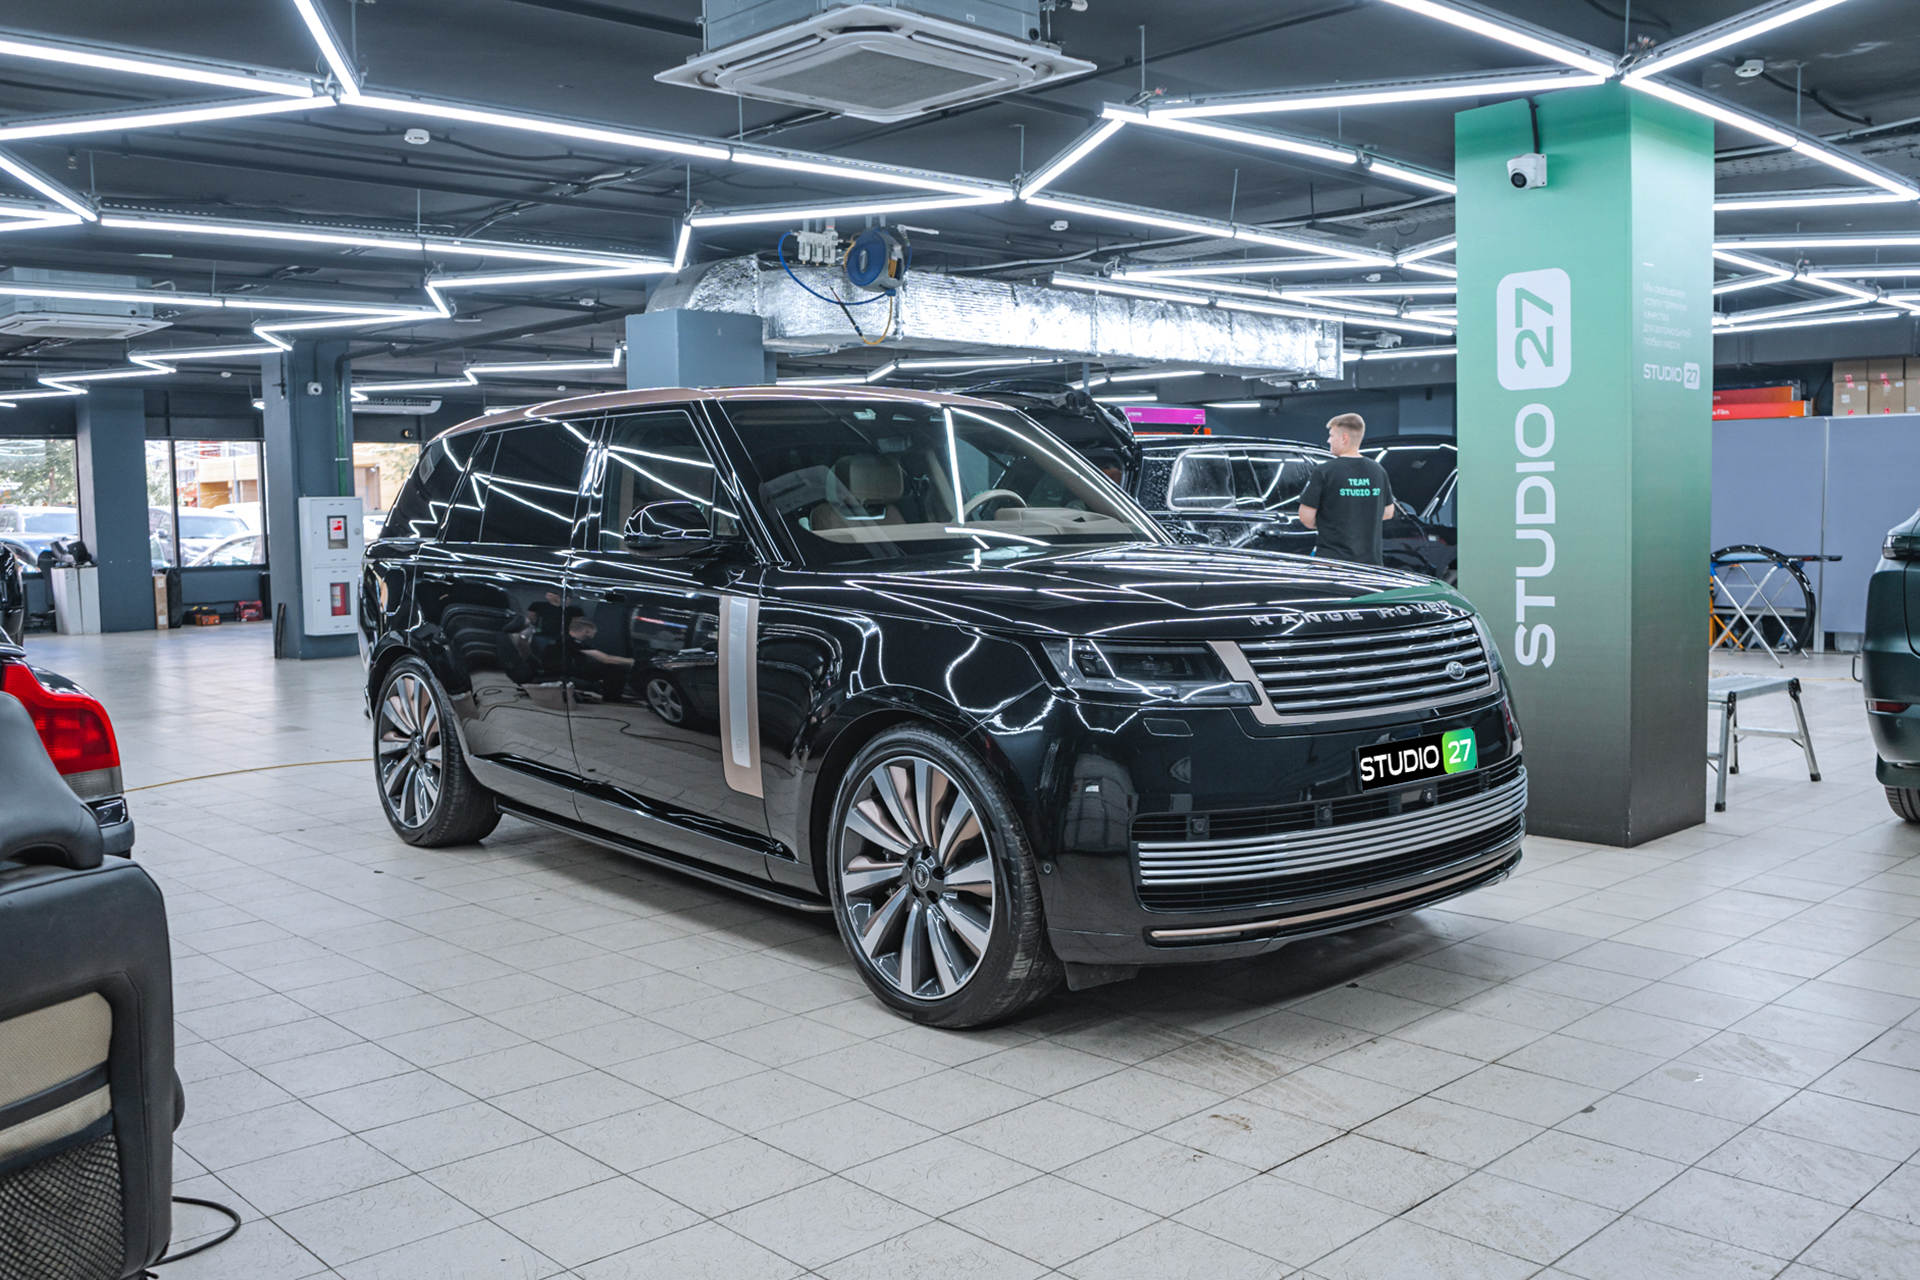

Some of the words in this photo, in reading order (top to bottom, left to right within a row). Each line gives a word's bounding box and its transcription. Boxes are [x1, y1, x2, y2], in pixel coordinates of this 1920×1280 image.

[1514, 287, 1554, 369] 27
[1643, 363, 1682, 382] STUDIO
[1339, 488, 1371, 496] STUDIO
[1347, 478, 1370, 486] TEAM
[1515, 403, 1556, 669] STUDIO
[1250, 612, 1363, 626] RANGE
[1376, 600, 1451, 619] ROVER
[1360, 745, 1440, 781] STUDIO
[1448, 738, 1471, 764] 27
